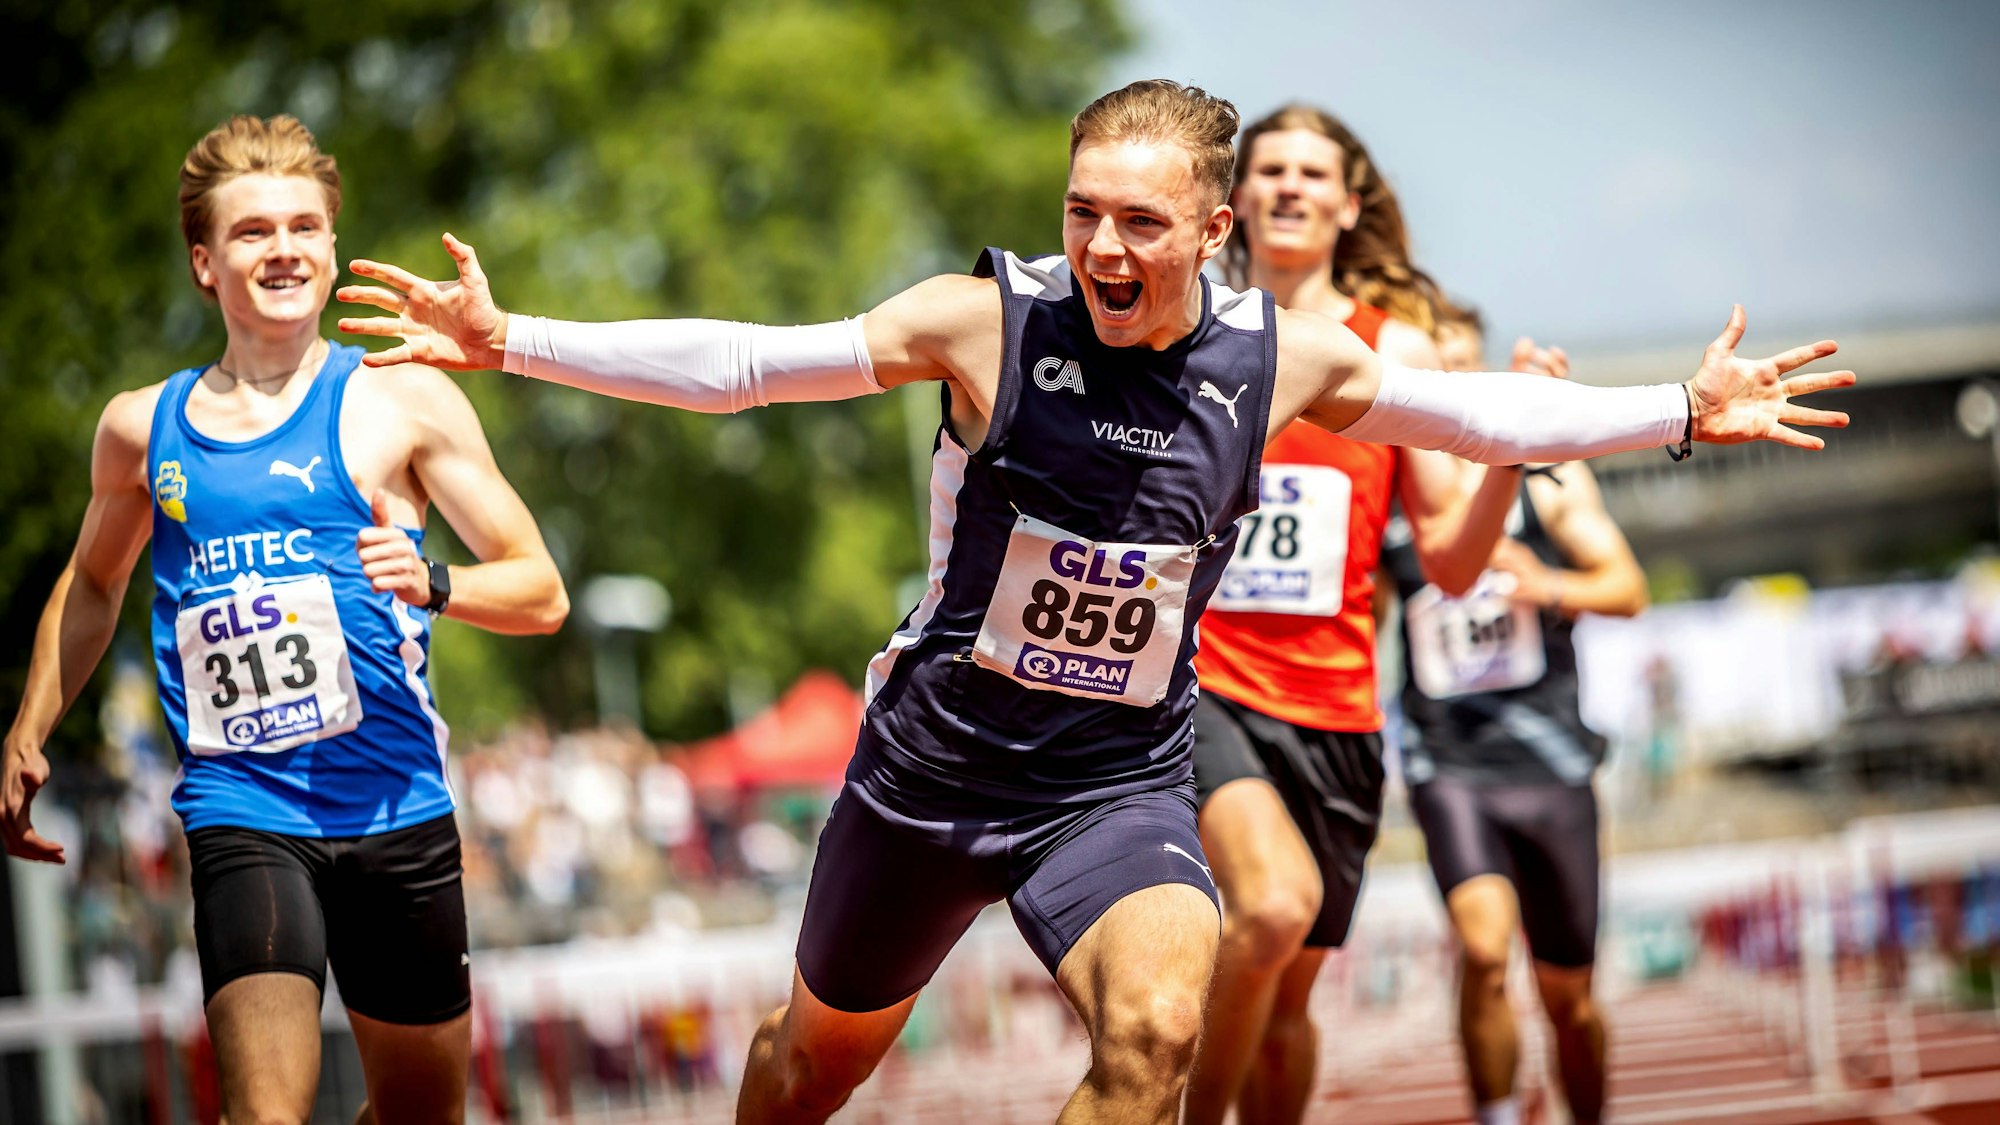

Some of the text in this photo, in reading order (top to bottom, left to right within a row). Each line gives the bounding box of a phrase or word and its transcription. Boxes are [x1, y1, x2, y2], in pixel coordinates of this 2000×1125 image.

[1091, 420, 1174, 450] VIACTIV
[1120, 444, 1172, 458] Krankenkasse
[189, 528, 315, 578] HEITEC
[1022, 579, 1156, 653] 859
[205, 634, 318, 709] 313
[1062, 677, 1121, 691] INTERNATIONAL
[1064, 659, 1127, 682] PLAN
[260, 701, 318, 731] PLAN
